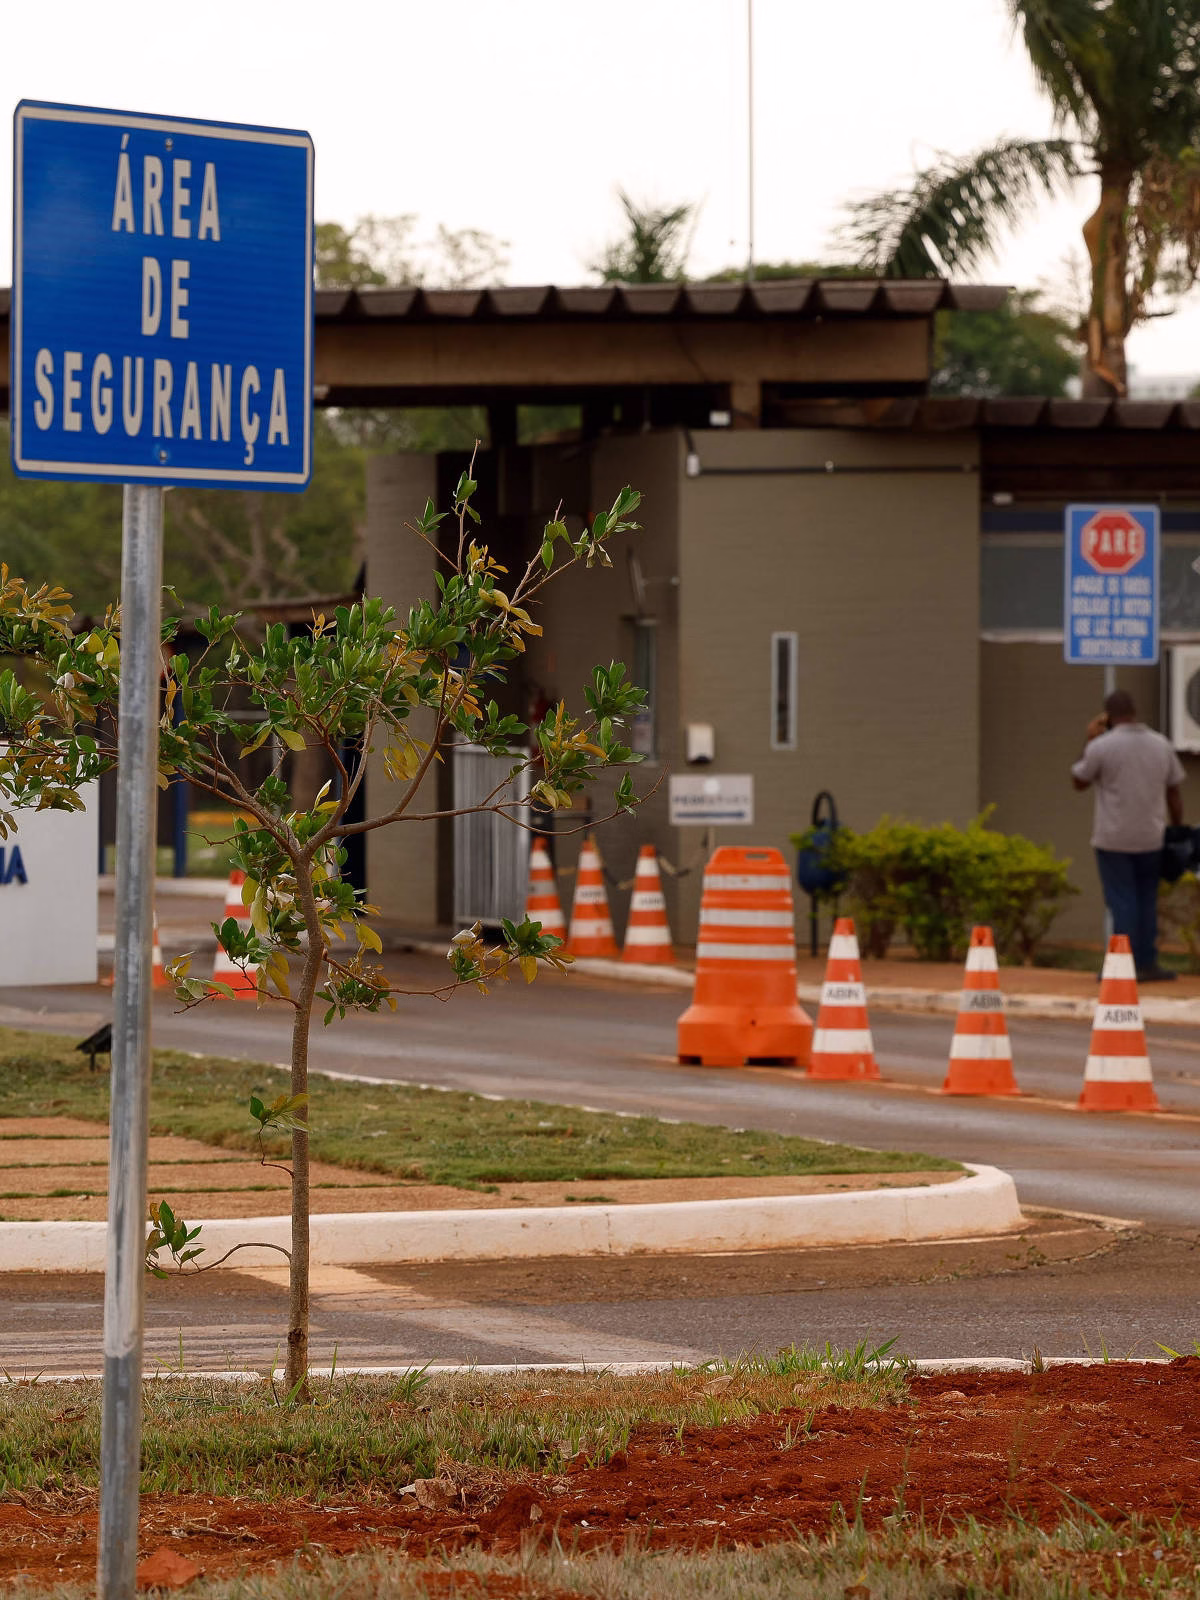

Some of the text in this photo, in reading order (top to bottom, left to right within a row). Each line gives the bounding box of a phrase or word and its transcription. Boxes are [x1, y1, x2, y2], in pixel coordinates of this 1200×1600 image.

[112, 133, 220, 241] ÁREA
[141, 256, 190, 339] DE
[34, 348, 289, 465] SEGURANÇA
[1087, 528, 1140, 554] PARE
